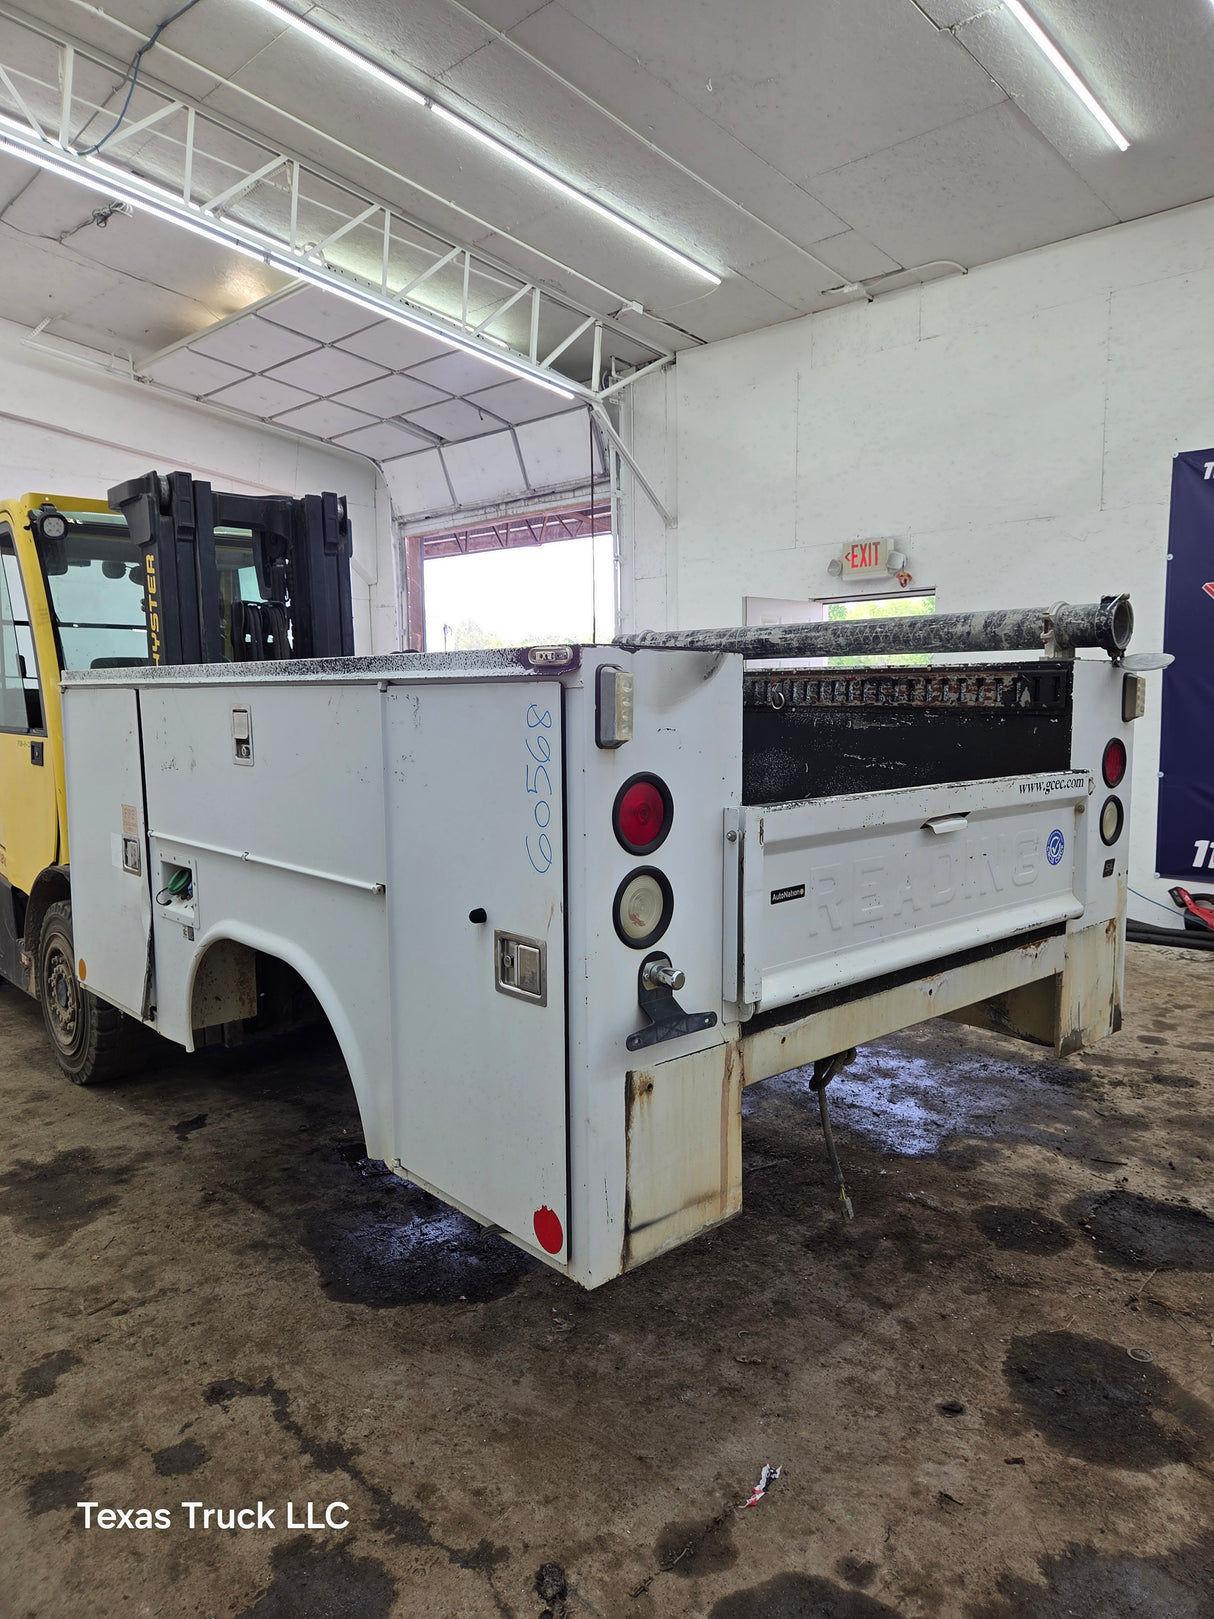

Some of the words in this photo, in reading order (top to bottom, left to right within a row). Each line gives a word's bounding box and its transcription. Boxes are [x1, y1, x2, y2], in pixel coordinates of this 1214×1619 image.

[851, 541, 881, 568] EXIT
[526, 704, 552, 873] 60568
[1019, 778, 1084, 795] www.gcec.com
[809, 828, 1039, 937] READING
